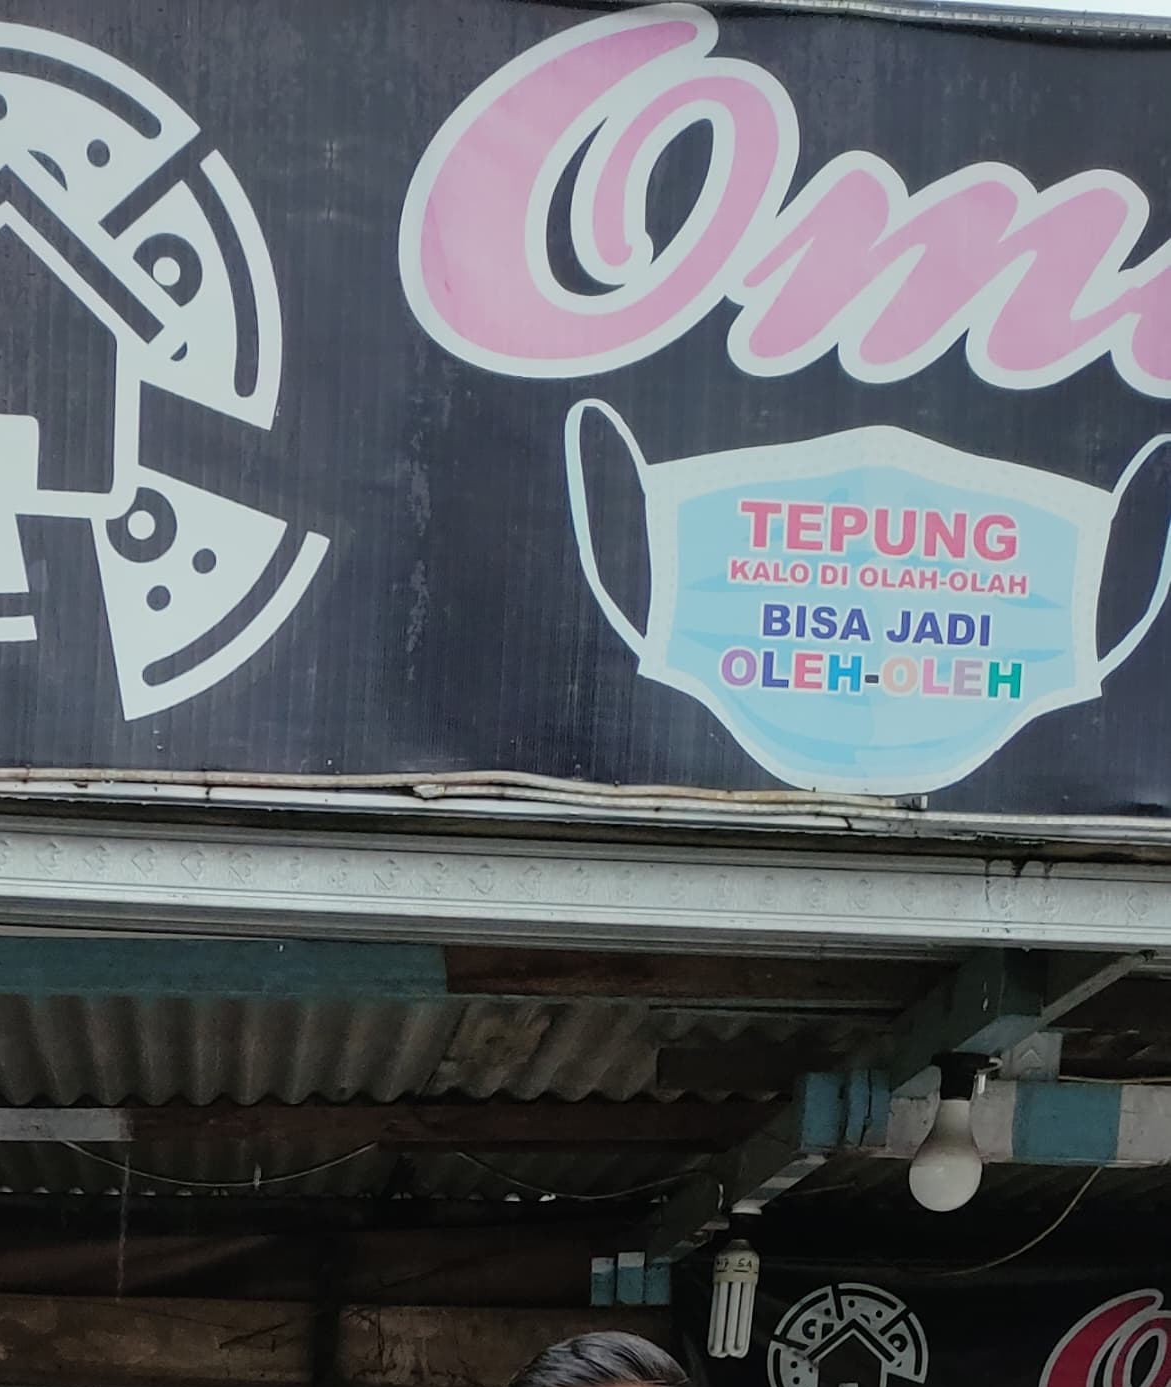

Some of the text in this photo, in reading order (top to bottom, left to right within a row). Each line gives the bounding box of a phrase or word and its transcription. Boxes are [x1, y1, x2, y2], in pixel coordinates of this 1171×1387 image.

[398, 2, 1171, 400] Om
[740, 500, 1018, 561] TEPUNG
[729, 559, 1028, 595] KALO DI OLAH-OLAH
[762, 603, 991, 647] BISA JADI
[720, 648, 1023, 700] OLEH-OLEH
